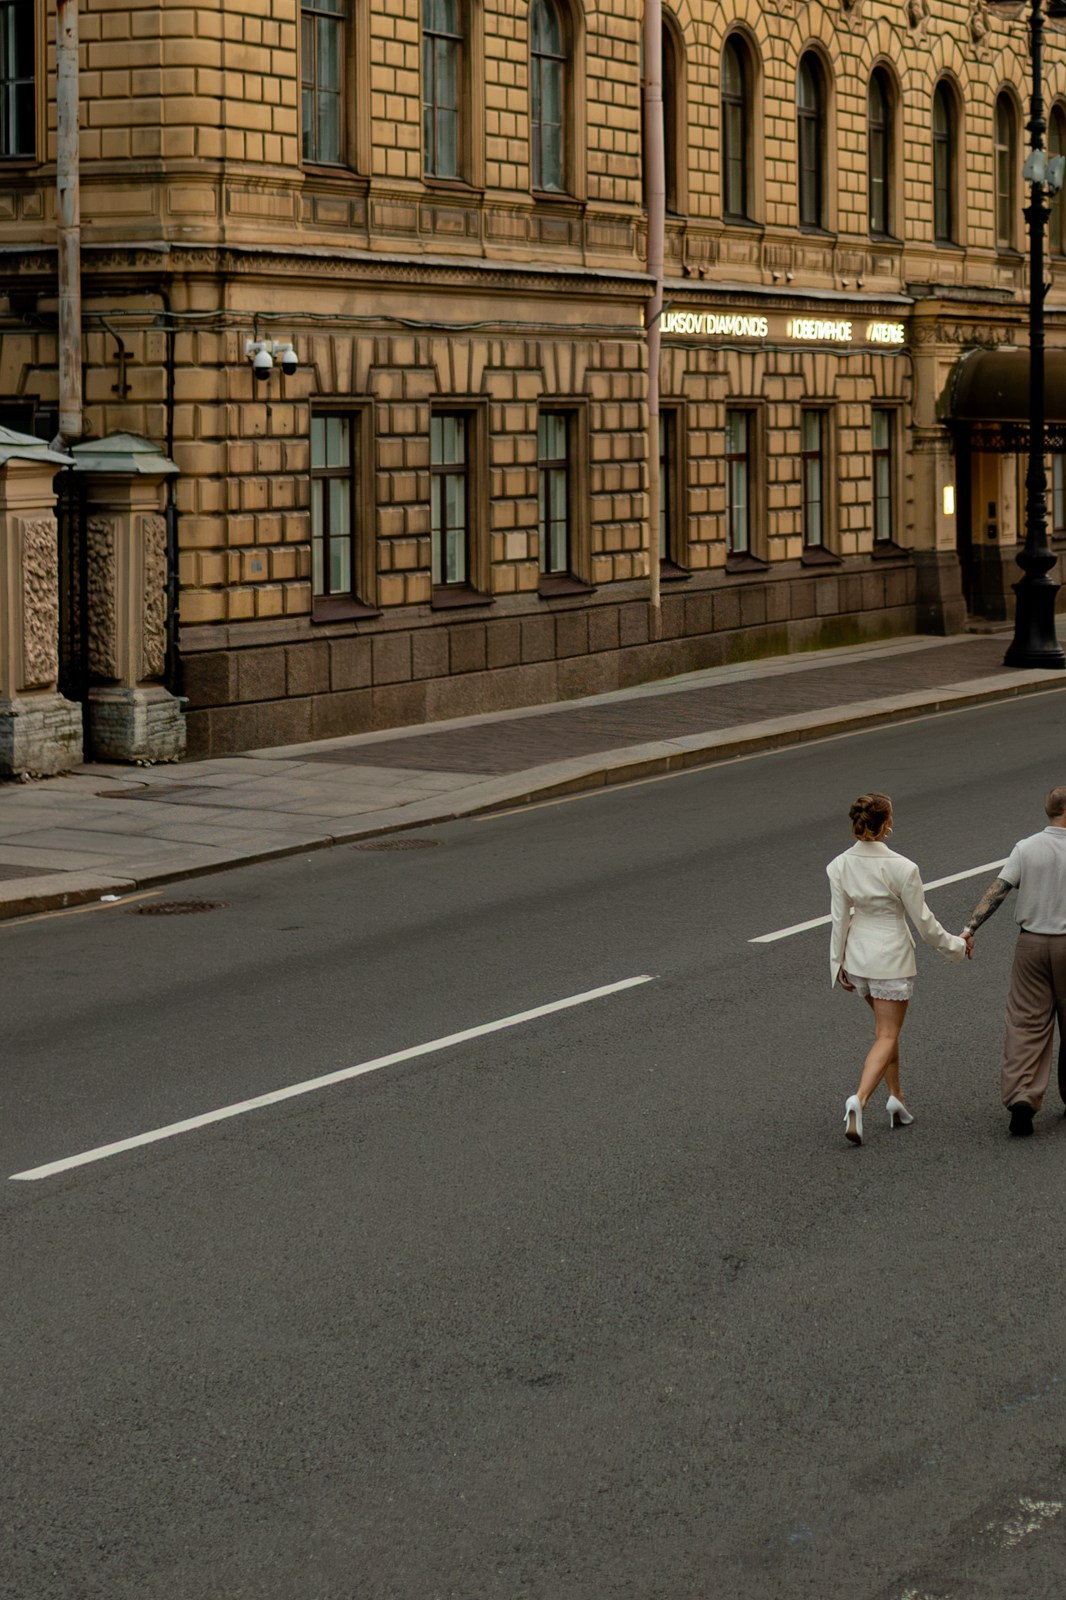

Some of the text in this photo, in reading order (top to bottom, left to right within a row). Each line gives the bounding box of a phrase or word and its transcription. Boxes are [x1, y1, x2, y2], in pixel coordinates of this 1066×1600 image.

[706, 314, 769, 337] DIAMONDS
[792, 319, 905, 343] ЮВЕЛИРНОЕ АТЕЛЬЕ
